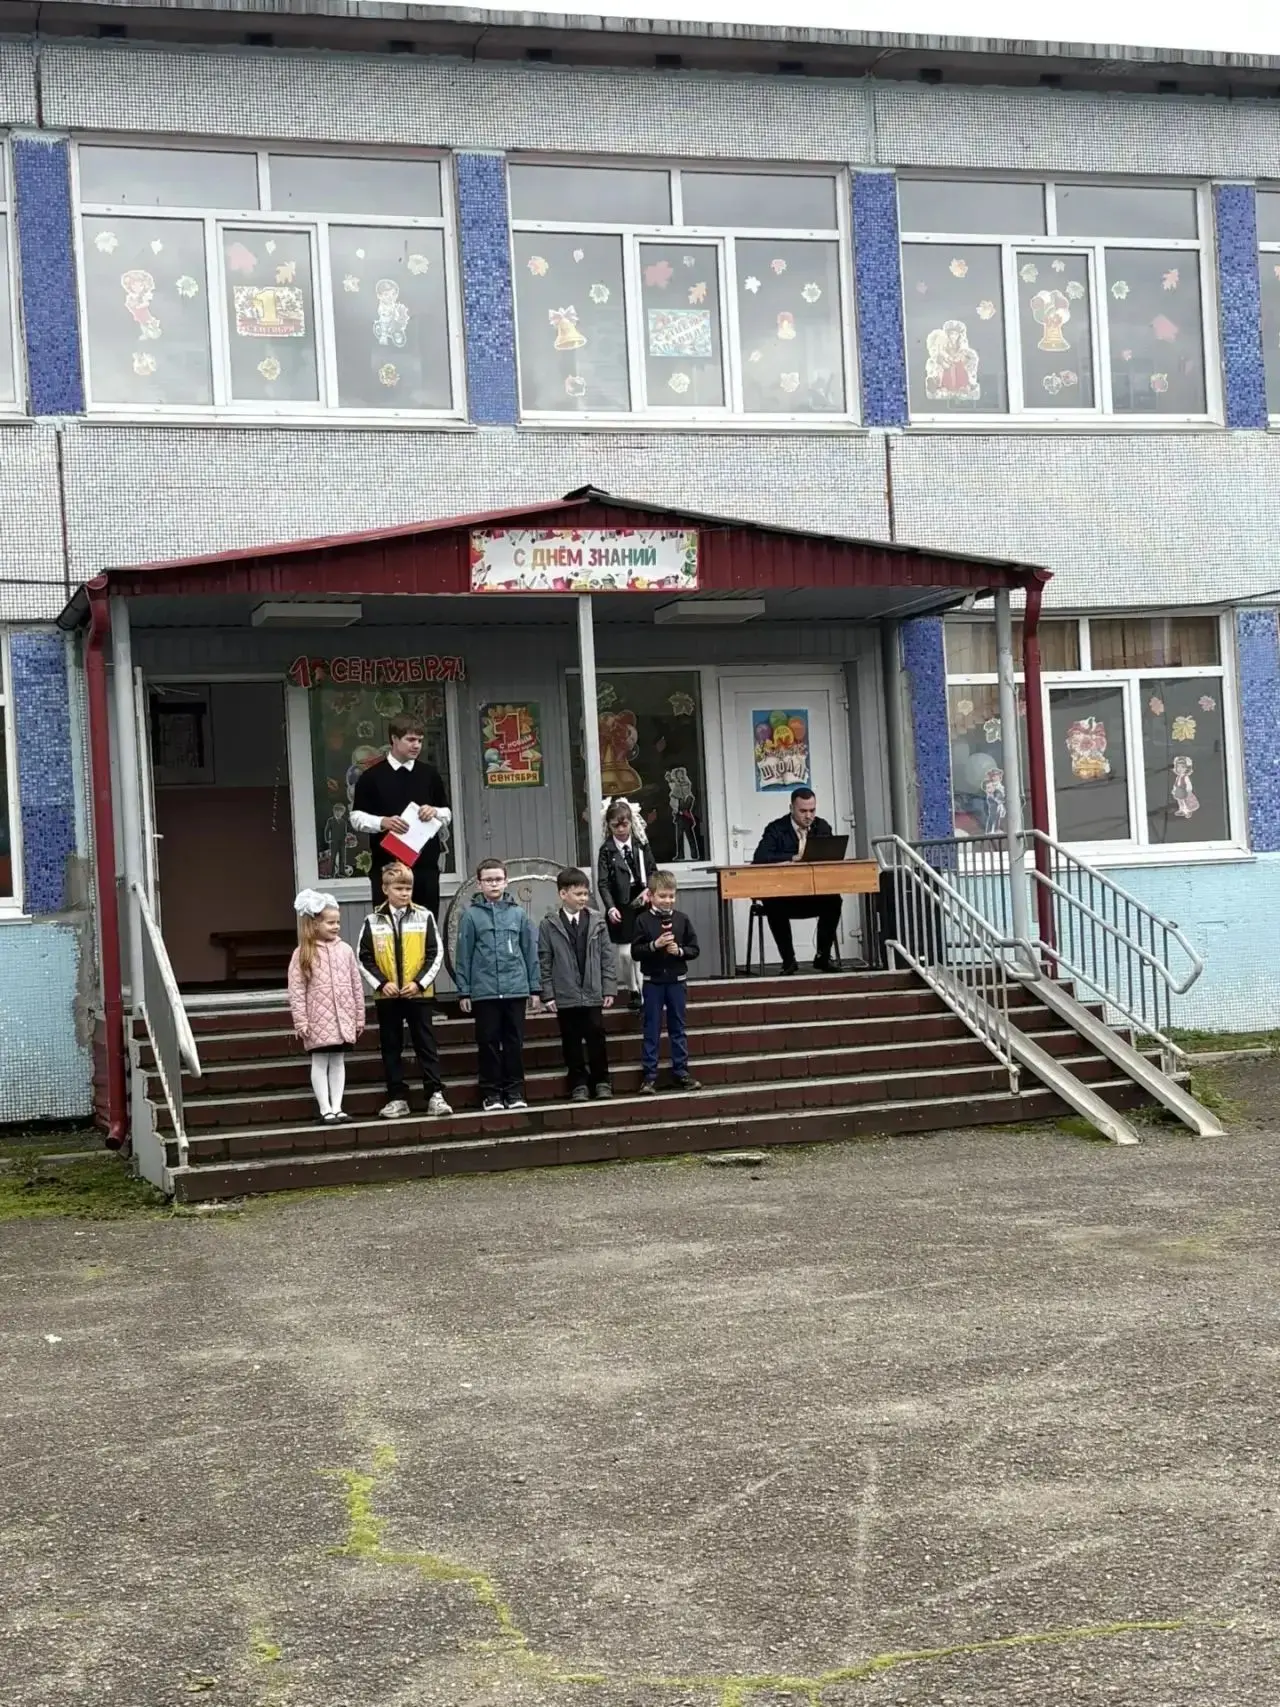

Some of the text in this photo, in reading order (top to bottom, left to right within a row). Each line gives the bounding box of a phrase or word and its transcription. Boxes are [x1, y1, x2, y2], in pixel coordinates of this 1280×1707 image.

[513, 544, 657, 571] С ДНЁМ ЗНАНИЙ
[330, 654, 466, 685] СЕНТЯБРЯ!
[494, 711, 531, 771] 1
